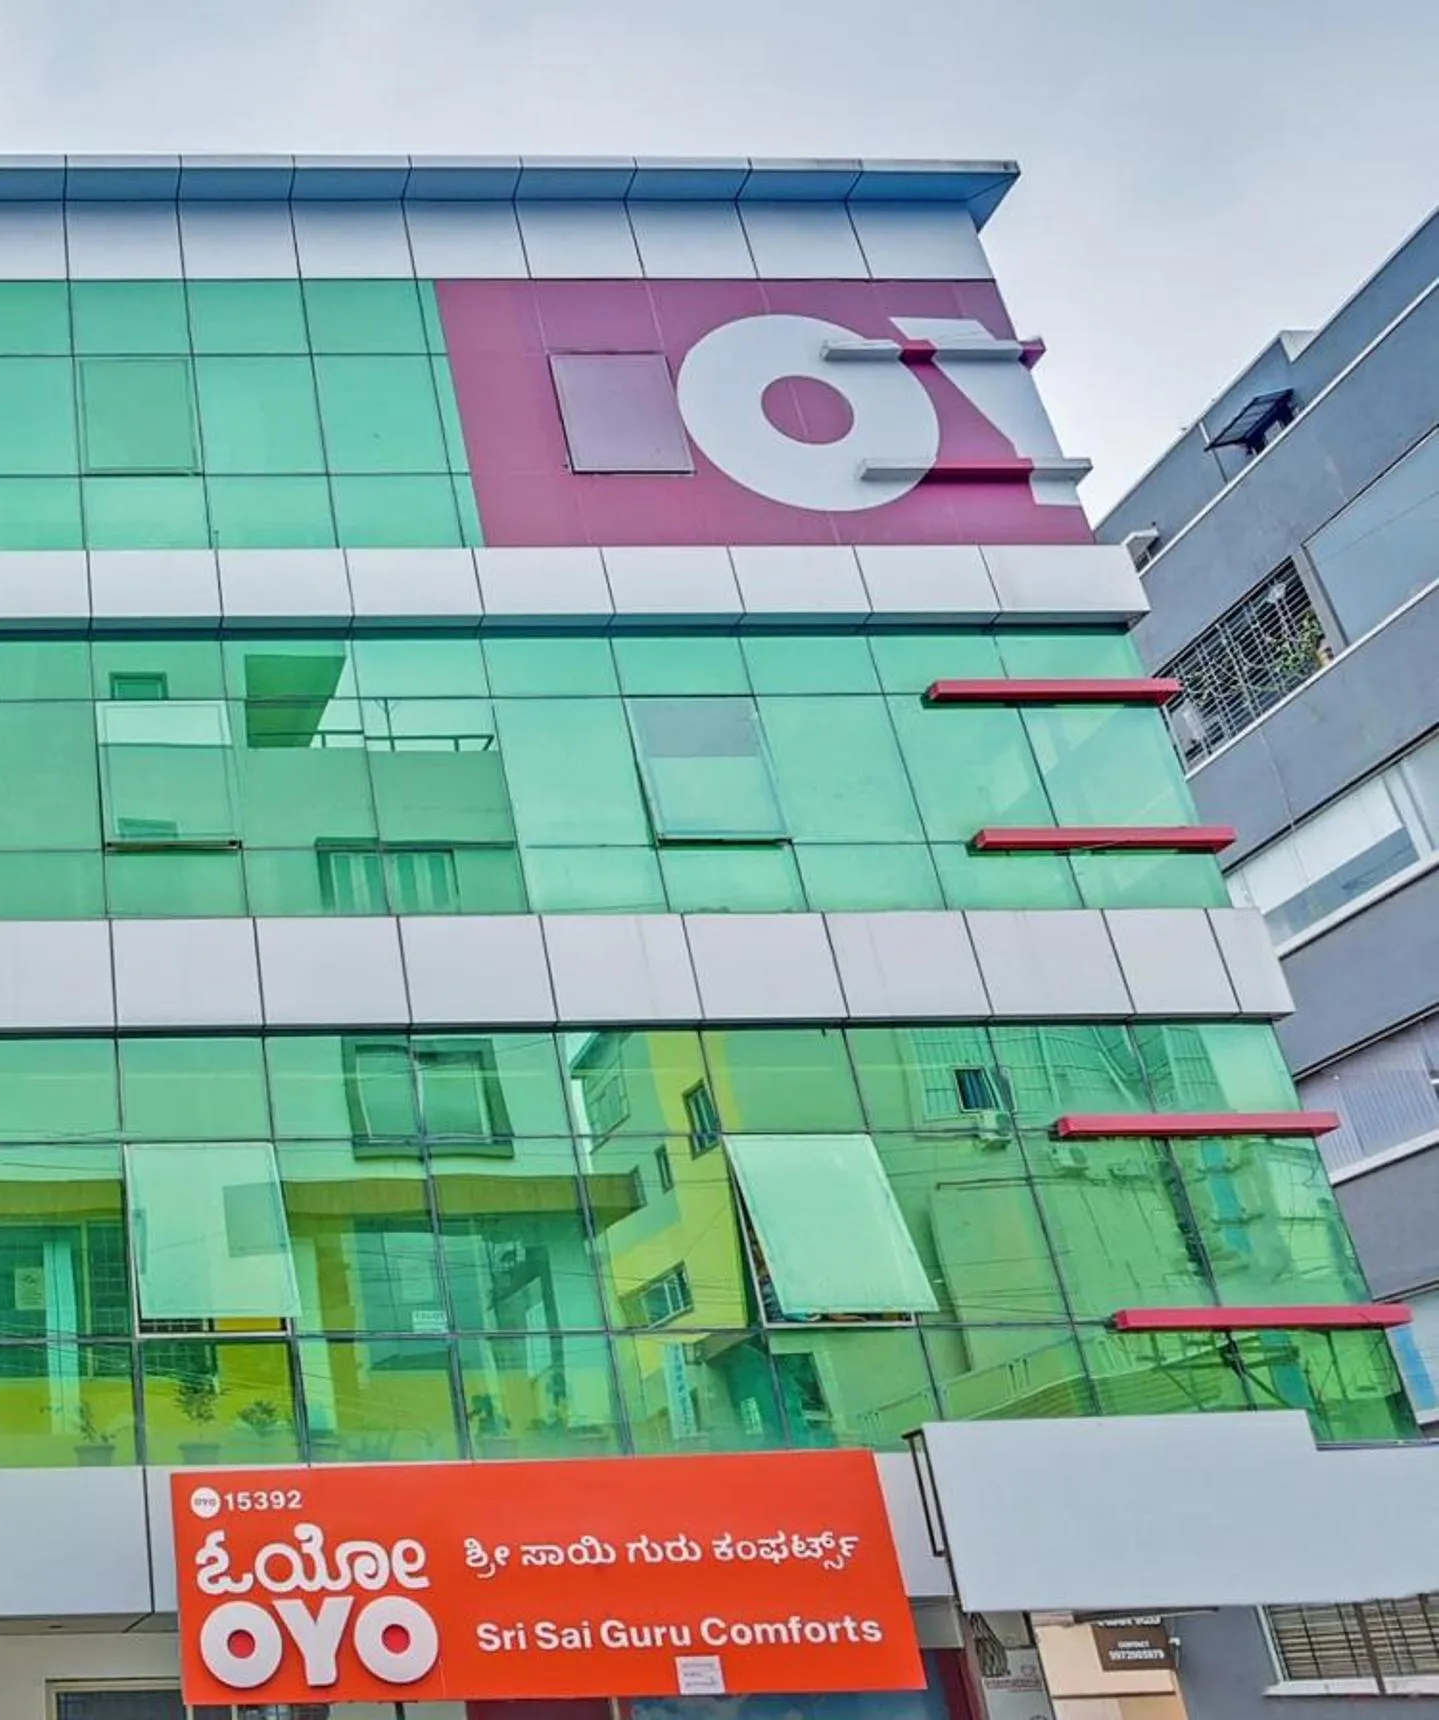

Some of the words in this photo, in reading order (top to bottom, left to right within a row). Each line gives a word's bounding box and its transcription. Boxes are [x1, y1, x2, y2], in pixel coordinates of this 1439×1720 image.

[224, 1489, 303, 1511] 15392
[195, 1522, 431, 1595] ಓಯೋ
[463, 1537, 511, 1579] ಶ್ರೀ
[520, 1535, 616, 1567] ಸಾಯಿ
[626, 1533, 703, 1564] ಗುರು
[200, 1595, 439, 1689] OYO
[475, 1620, 527, 1652] Sri
[534, 1619, 593, 1650] Sai
[599, 1618, 692, 1649] Guru
[699, 1614, 883, 1647] Comforts
